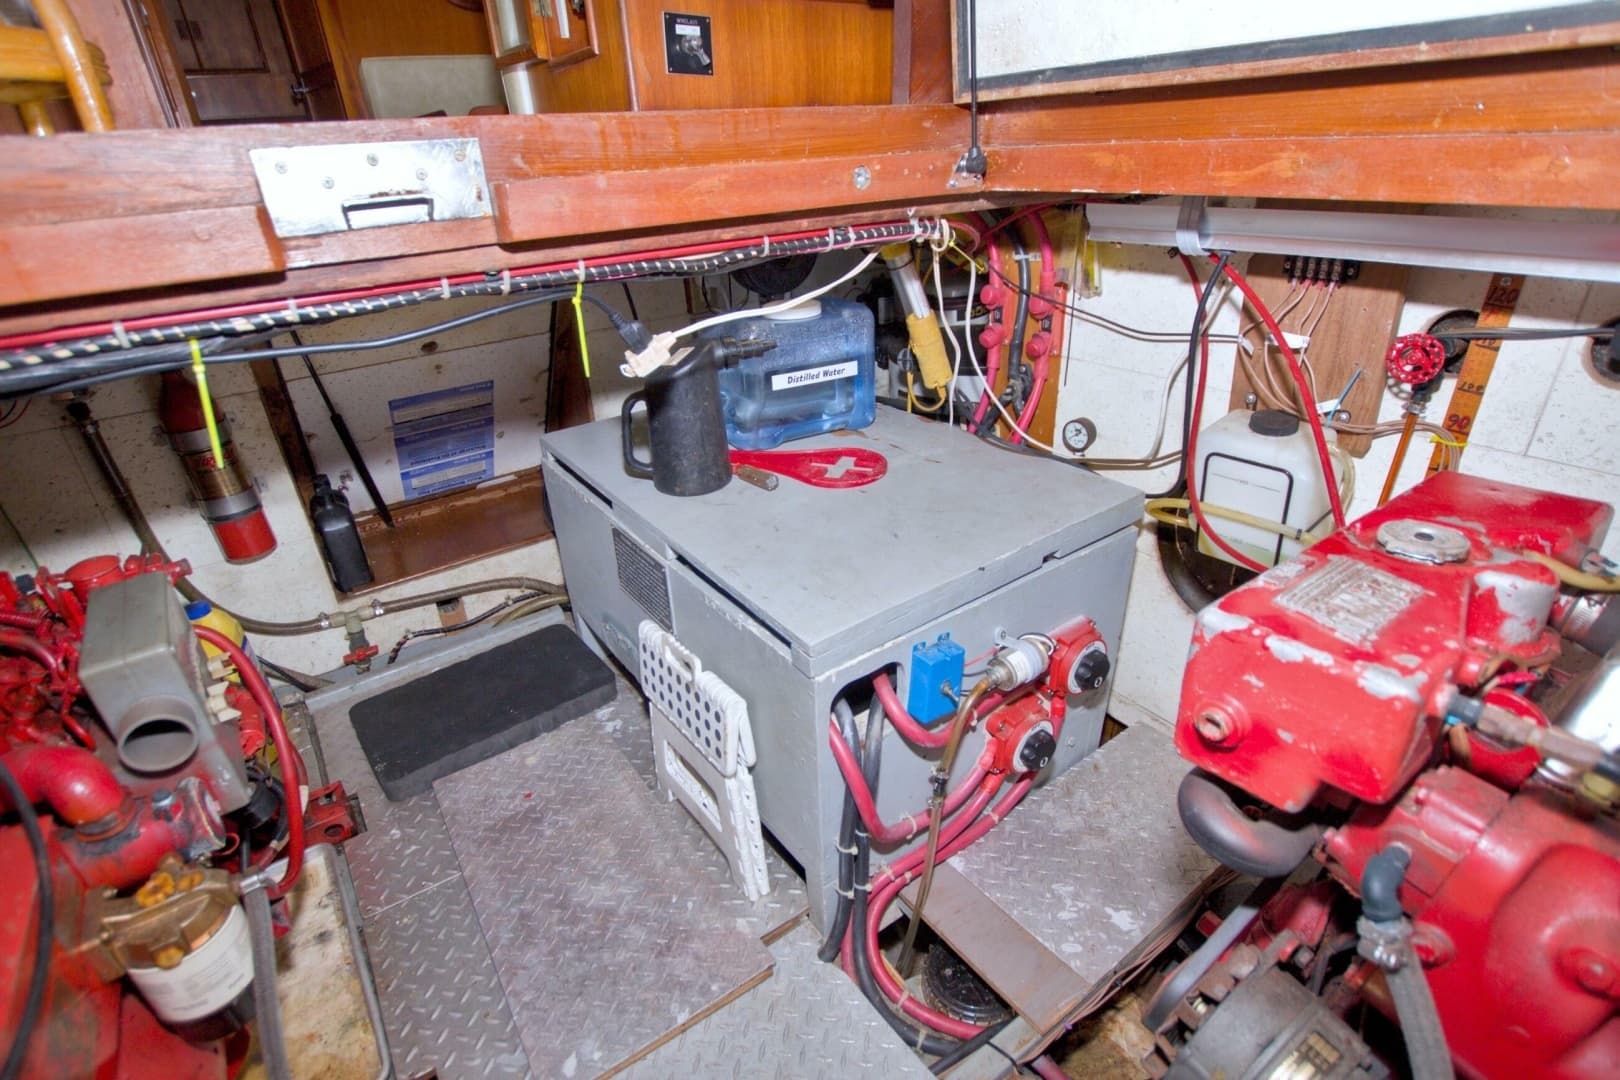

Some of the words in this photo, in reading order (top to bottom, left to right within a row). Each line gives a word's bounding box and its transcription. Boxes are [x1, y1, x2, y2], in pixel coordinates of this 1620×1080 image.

[1487, 285, 1519, 304] 120
[787, 370, 820, 385] Distilled
[822, 367, 846, 377] Water
[1447, 413, 1471, 430] 90
